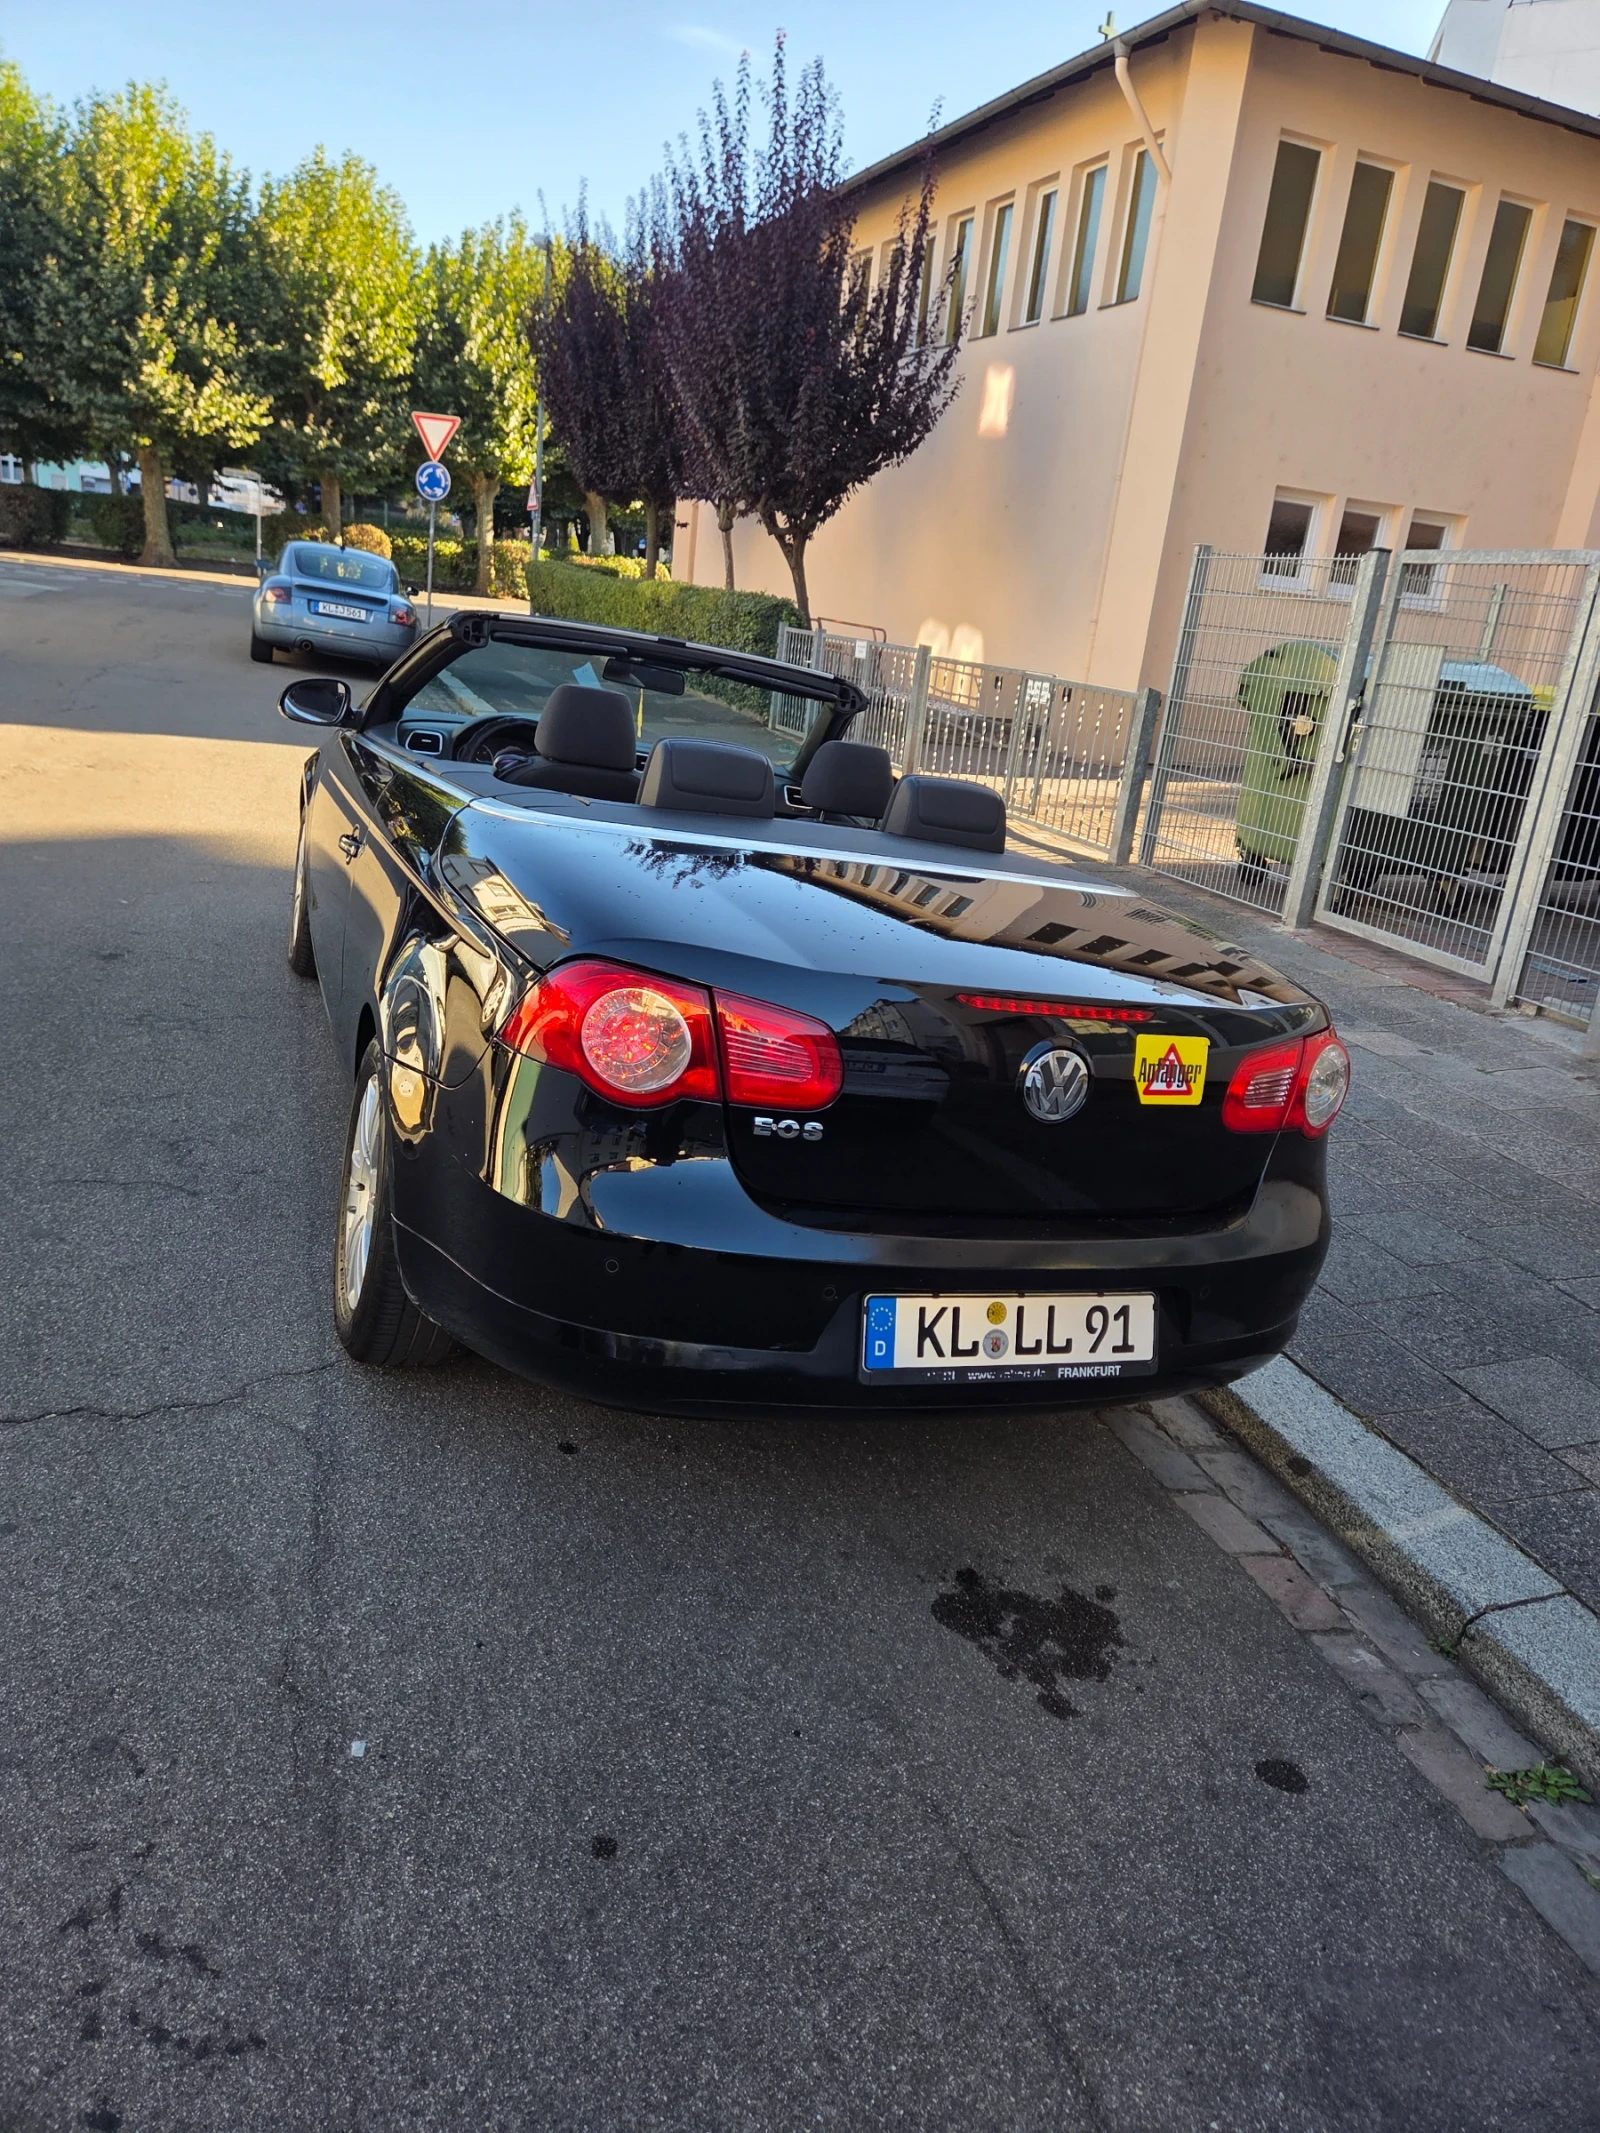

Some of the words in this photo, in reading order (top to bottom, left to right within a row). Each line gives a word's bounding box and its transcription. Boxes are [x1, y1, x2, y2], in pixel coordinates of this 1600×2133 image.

[322, 603, 333, 613] KL
[1024, 1050, 1089, 1121] VW
[753, 1116, 824, 1141] EOS
[917, 1306, 980, 1358] KL
[1015, 1305, 1072, 1355] LL
[1085, 1304, 1135, 1354] 91
[875, 1341, 886, 1356] D
[1057, 1365, 1121, 1379] FRANKFURT
